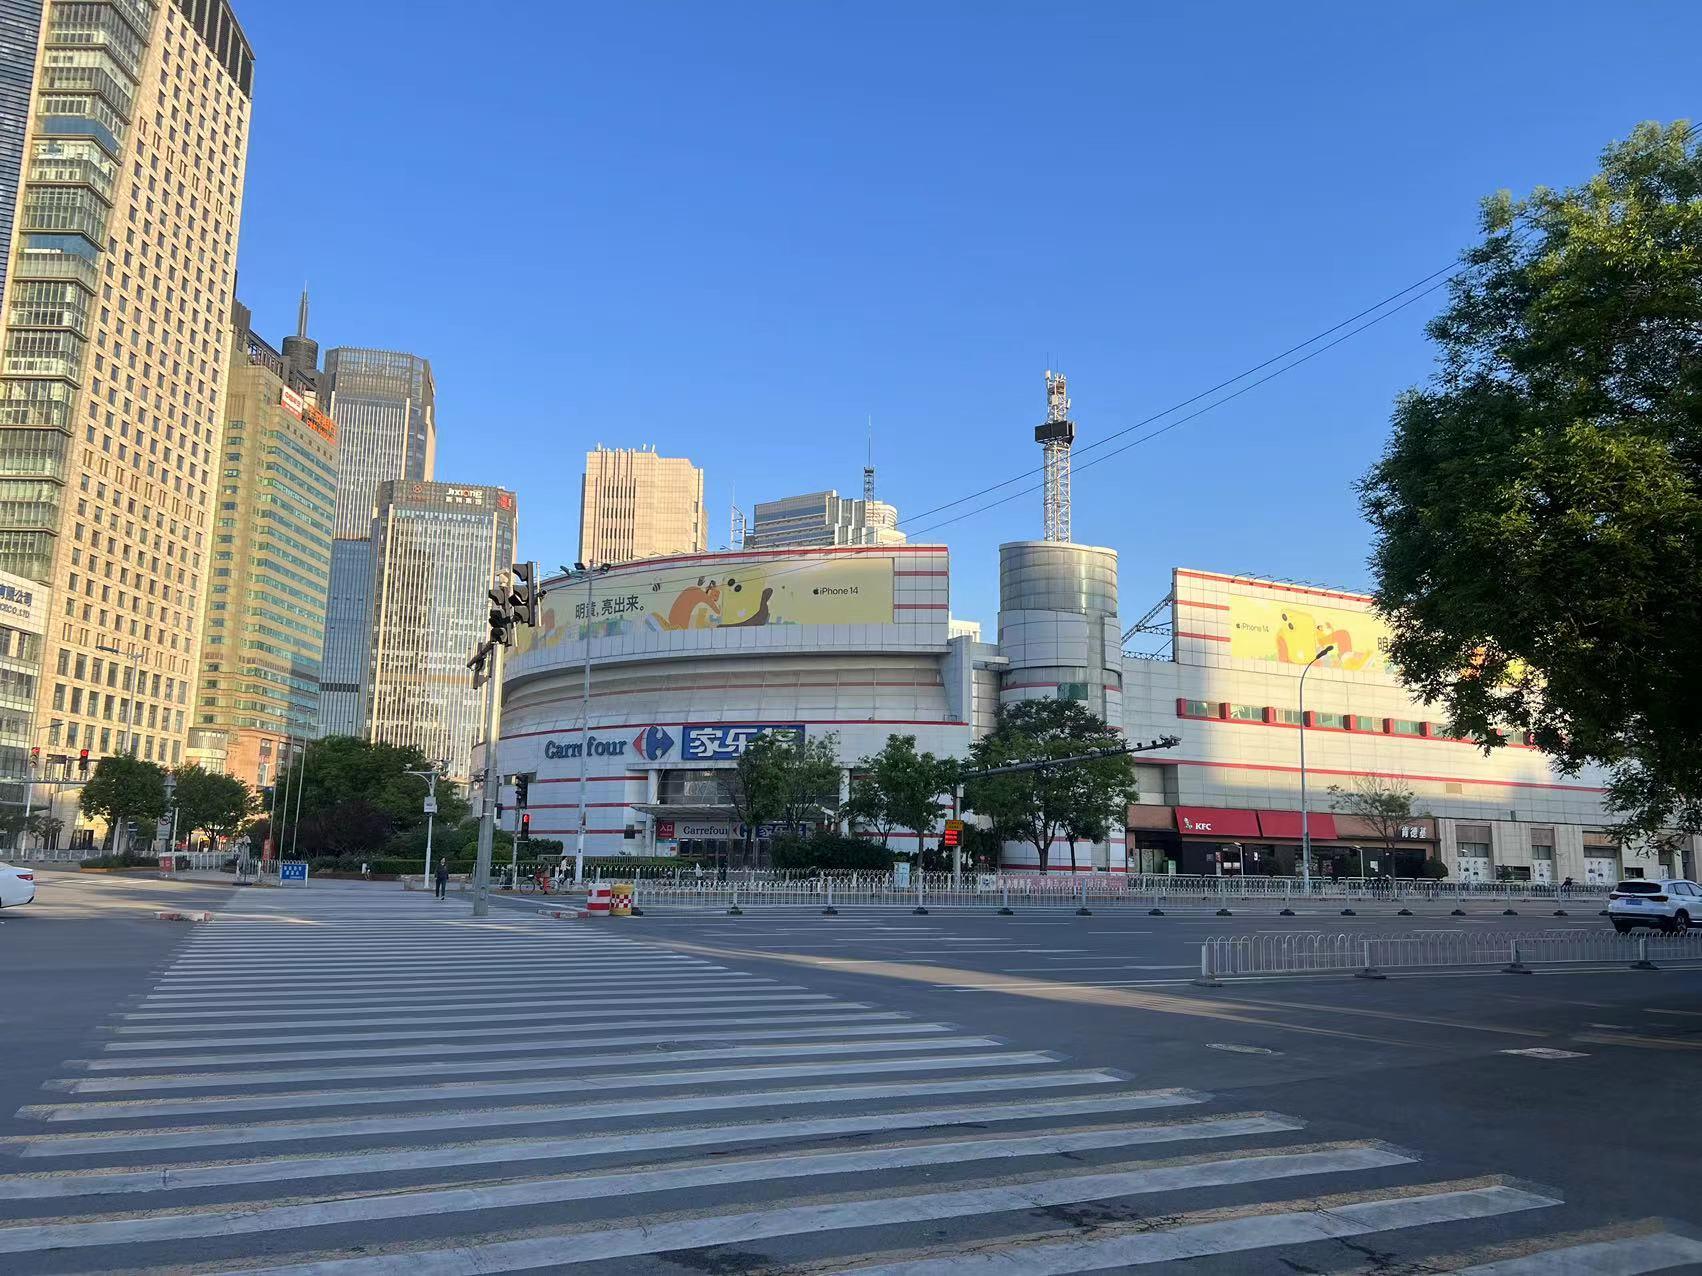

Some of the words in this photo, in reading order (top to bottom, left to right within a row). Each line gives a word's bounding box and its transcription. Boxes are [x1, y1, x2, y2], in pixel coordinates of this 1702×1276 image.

[820, 587, 849, 595] iPhone
[850, 586, 859, 594] 14
[659, 825, 673, 833] 入口
[1195, 822, 1212, 831] KFC
[1401, 826, 1426, 838] 肯德基
